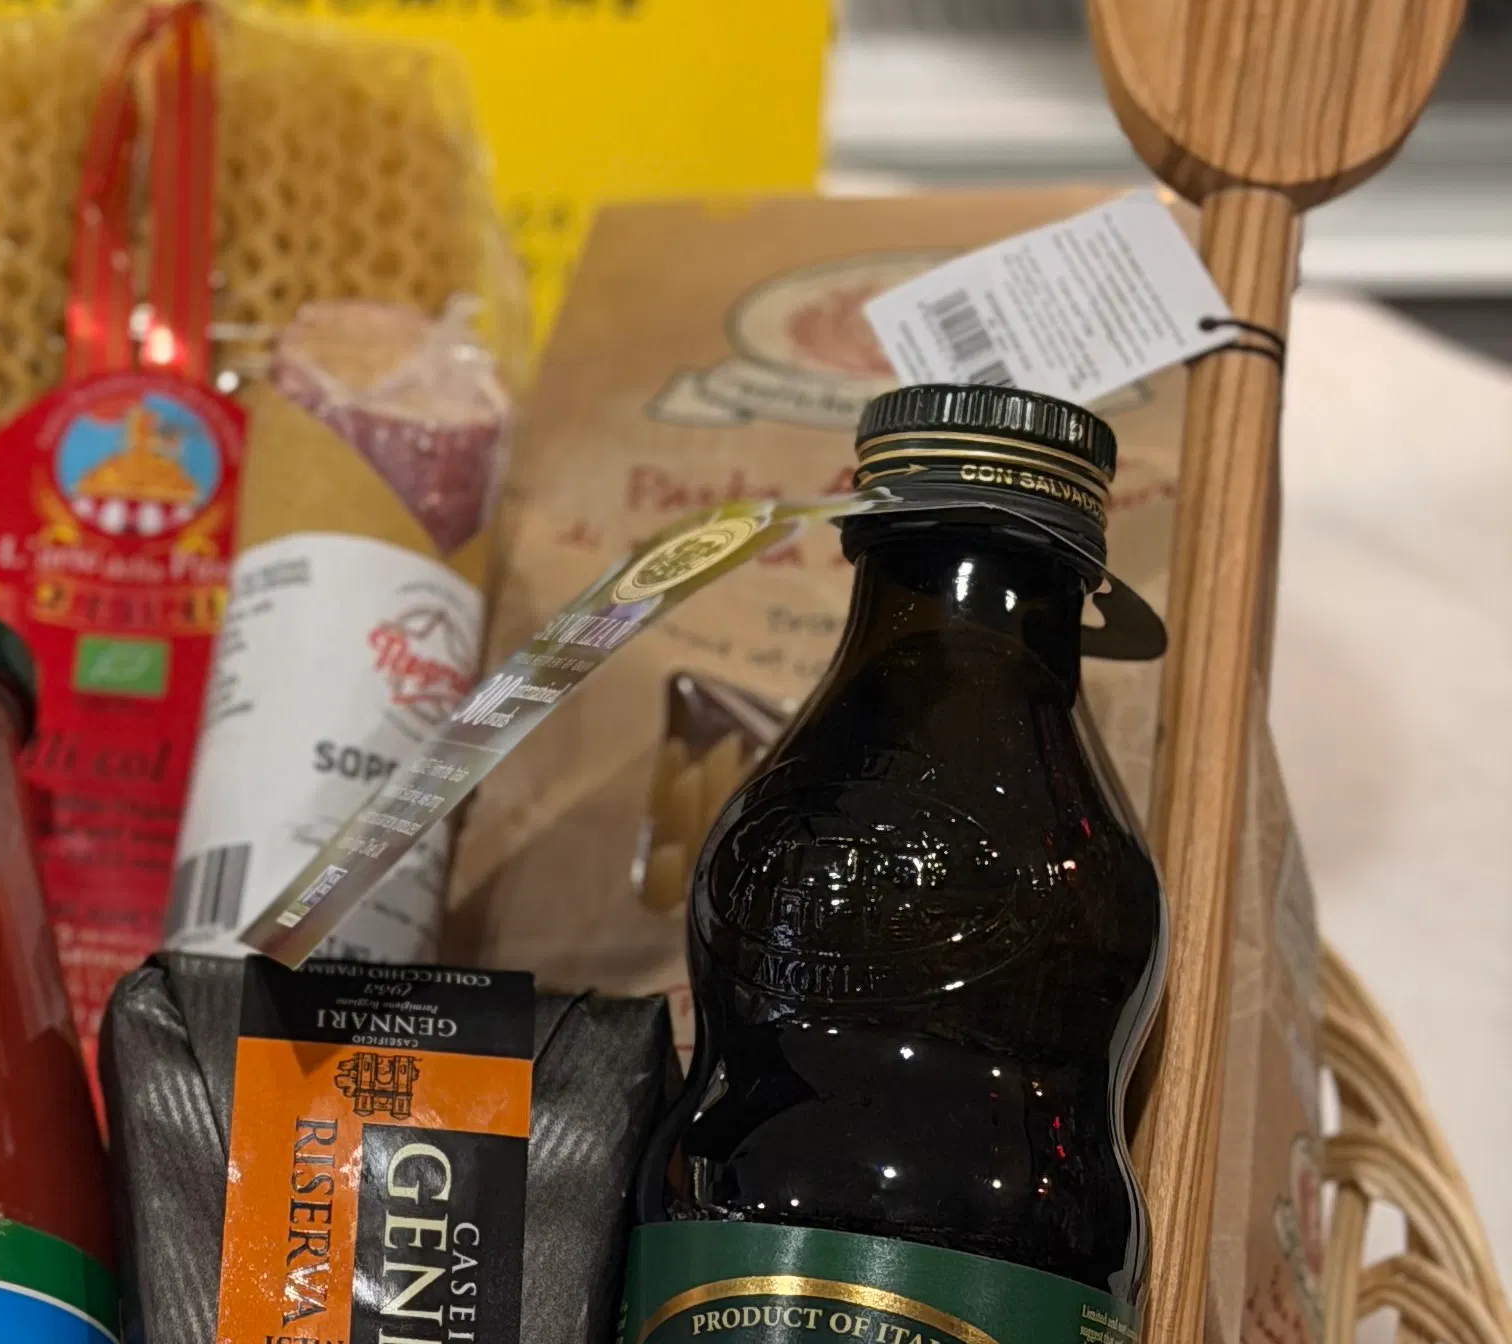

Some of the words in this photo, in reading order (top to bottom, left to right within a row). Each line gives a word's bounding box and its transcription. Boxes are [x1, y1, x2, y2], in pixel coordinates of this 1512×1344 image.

[959, 463, 1013, 486] CON
[317, 1008, 457, 1037] GENNARI
[352, 1034, 419, 1048] CASEIFICIO
[281, 1117, 338, 1327] RISERVA
[692, 1306, 822, 1336] PRODUCT
[829, 1313, 872, 1338] OF
